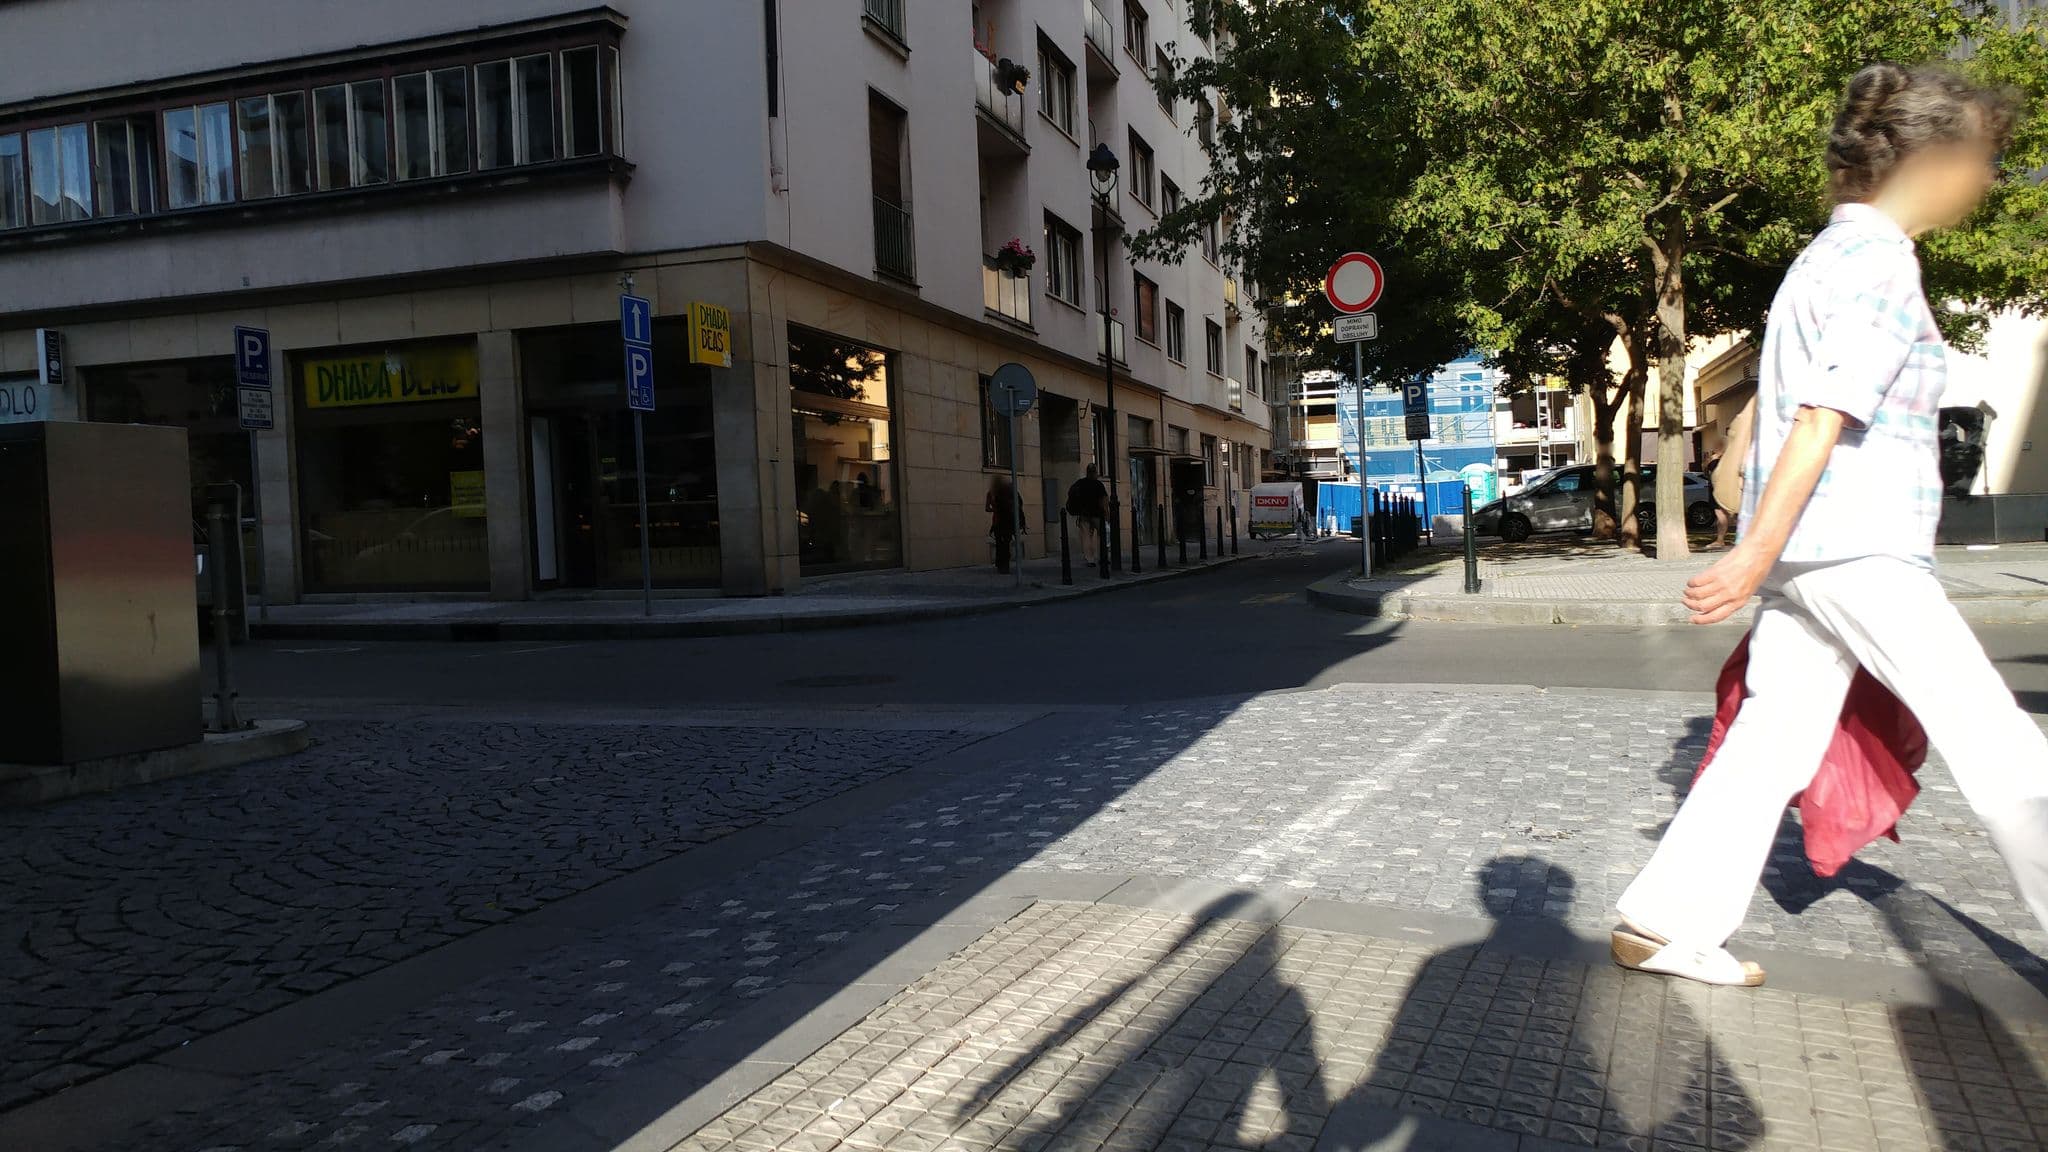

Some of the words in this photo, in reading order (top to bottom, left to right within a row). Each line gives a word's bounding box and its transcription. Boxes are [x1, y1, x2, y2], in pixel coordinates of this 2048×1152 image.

[1340, 323, 1369, 332] DOPRAVNÍ
[1342, 330, 1369, 338] OBSLUHY
[243, 335, 263, 368] P
[631, 352, 648, 389] P
[1407, 385, 1422, 405] P
[1256, 497, 1287, 505] DKNV
